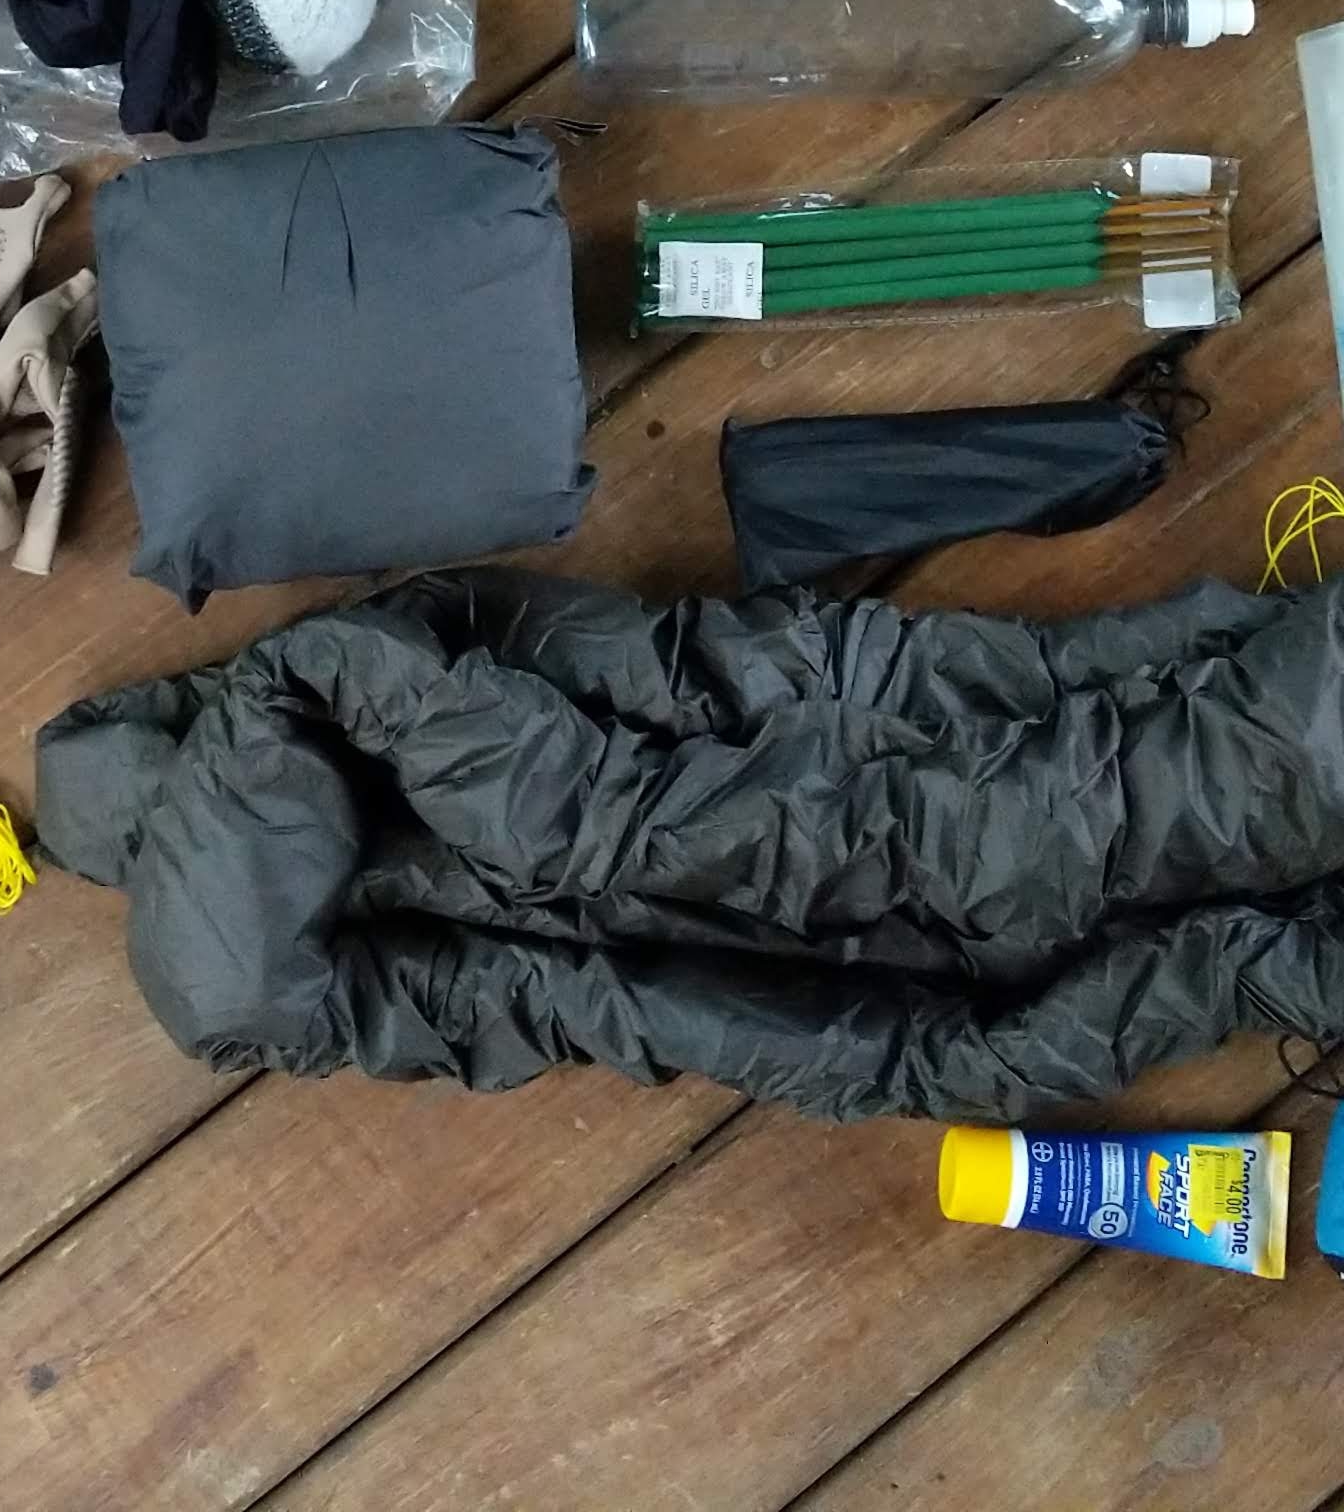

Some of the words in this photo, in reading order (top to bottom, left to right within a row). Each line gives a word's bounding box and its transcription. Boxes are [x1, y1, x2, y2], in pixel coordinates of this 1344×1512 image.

[690, 259, 699, 296] SILICA
[1158, 1170, 1174, 1227] FACE
[1174, 1152, 1191, 1239] SPORT
[1100, 1210, 1120, 1235] 50
